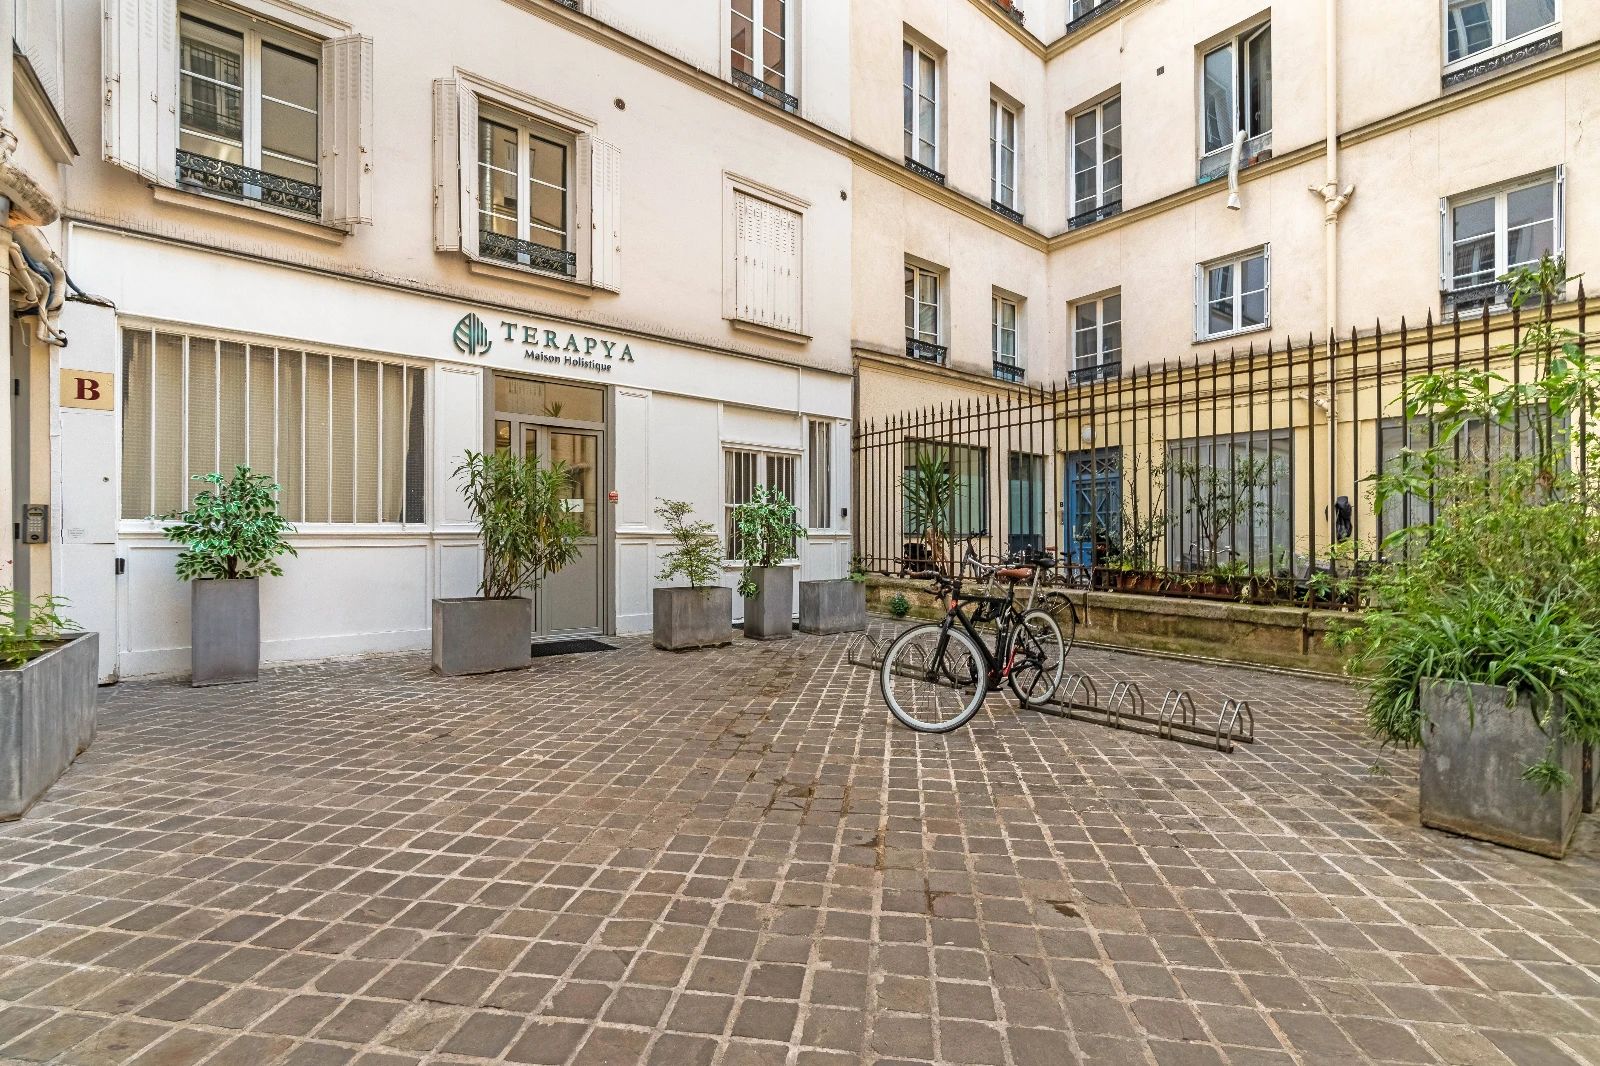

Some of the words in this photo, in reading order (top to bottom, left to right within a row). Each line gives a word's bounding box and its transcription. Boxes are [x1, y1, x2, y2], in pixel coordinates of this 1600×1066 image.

[500, 320, 635, 363] TERAPYA
[523, 350, 561, 364] Maison
[564, 355, 612, 373] Holistique
[74, 377, 101, 401] B
